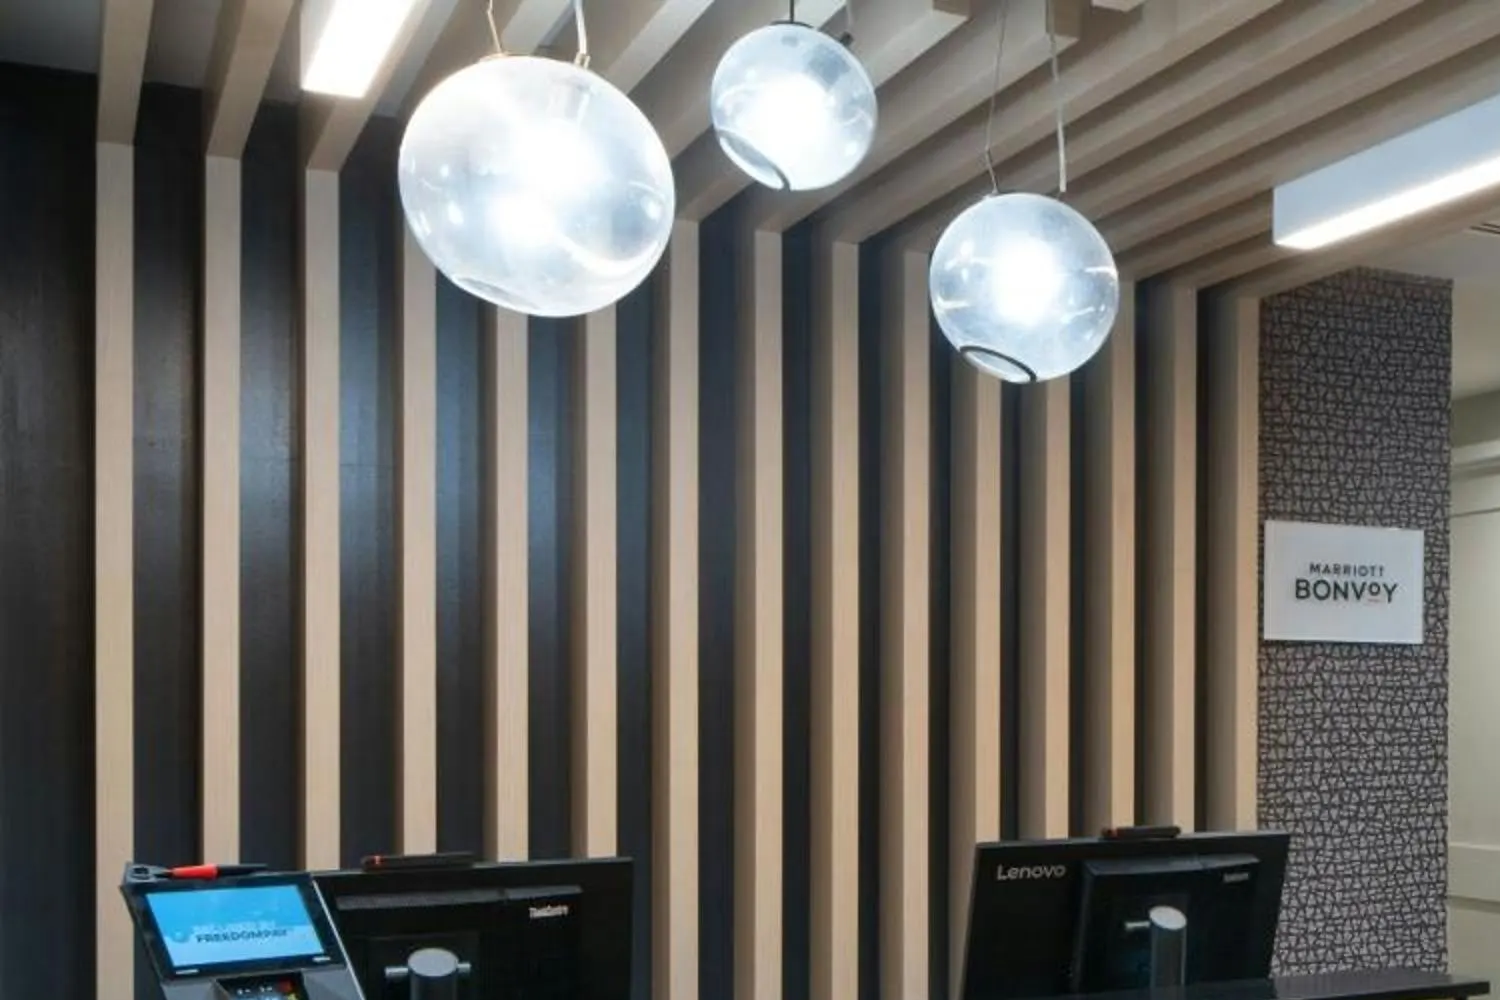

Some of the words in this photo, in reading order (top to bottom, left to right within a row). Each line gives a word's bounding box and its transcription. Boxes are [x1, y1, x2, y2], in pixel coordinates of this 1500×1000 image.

[1309, 562, 1385, 577] MARRIOTT
[1294, 578, 1398, 604] BONVOY
[996, 864, 1066, 881] Lenovo
